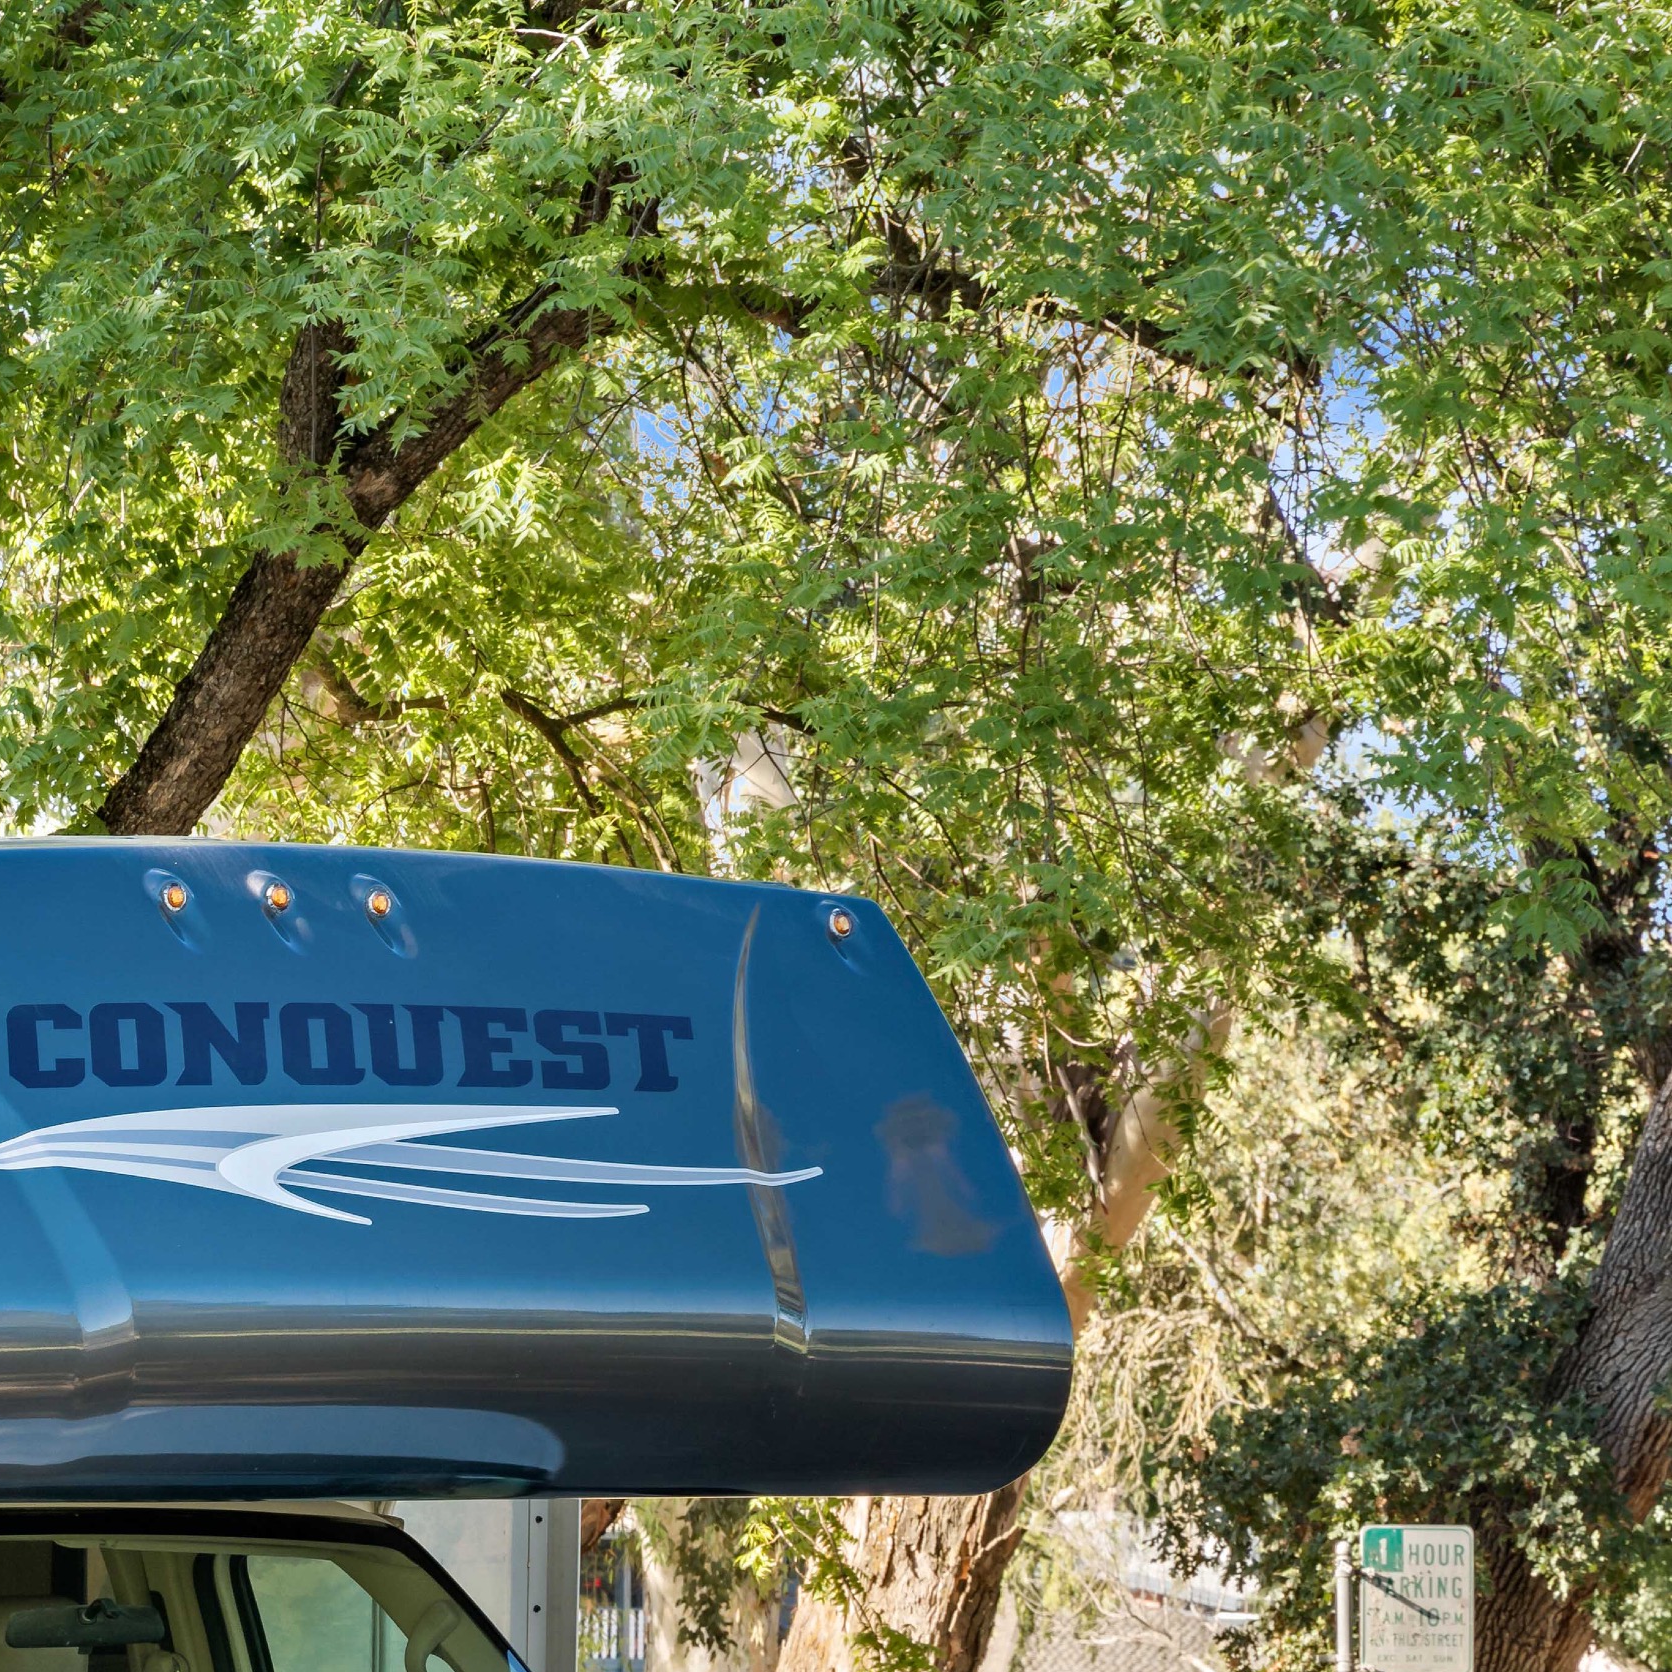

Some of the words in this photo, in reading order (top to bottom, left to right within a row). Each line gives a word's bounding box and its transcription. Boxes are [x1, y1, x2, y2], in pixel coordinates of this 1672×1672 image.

[7, 1002, 693, 1092] CONQUEST
[1379, 1538, 1387, 1565] 1
[1409, 1544, 1464, 1566] HOUR
[1375, 1576, 1463, 1599] ARKING
[1393, 1633, 1420, 1647] THIS
[1425, 1634, 1464, 1647] STREET
